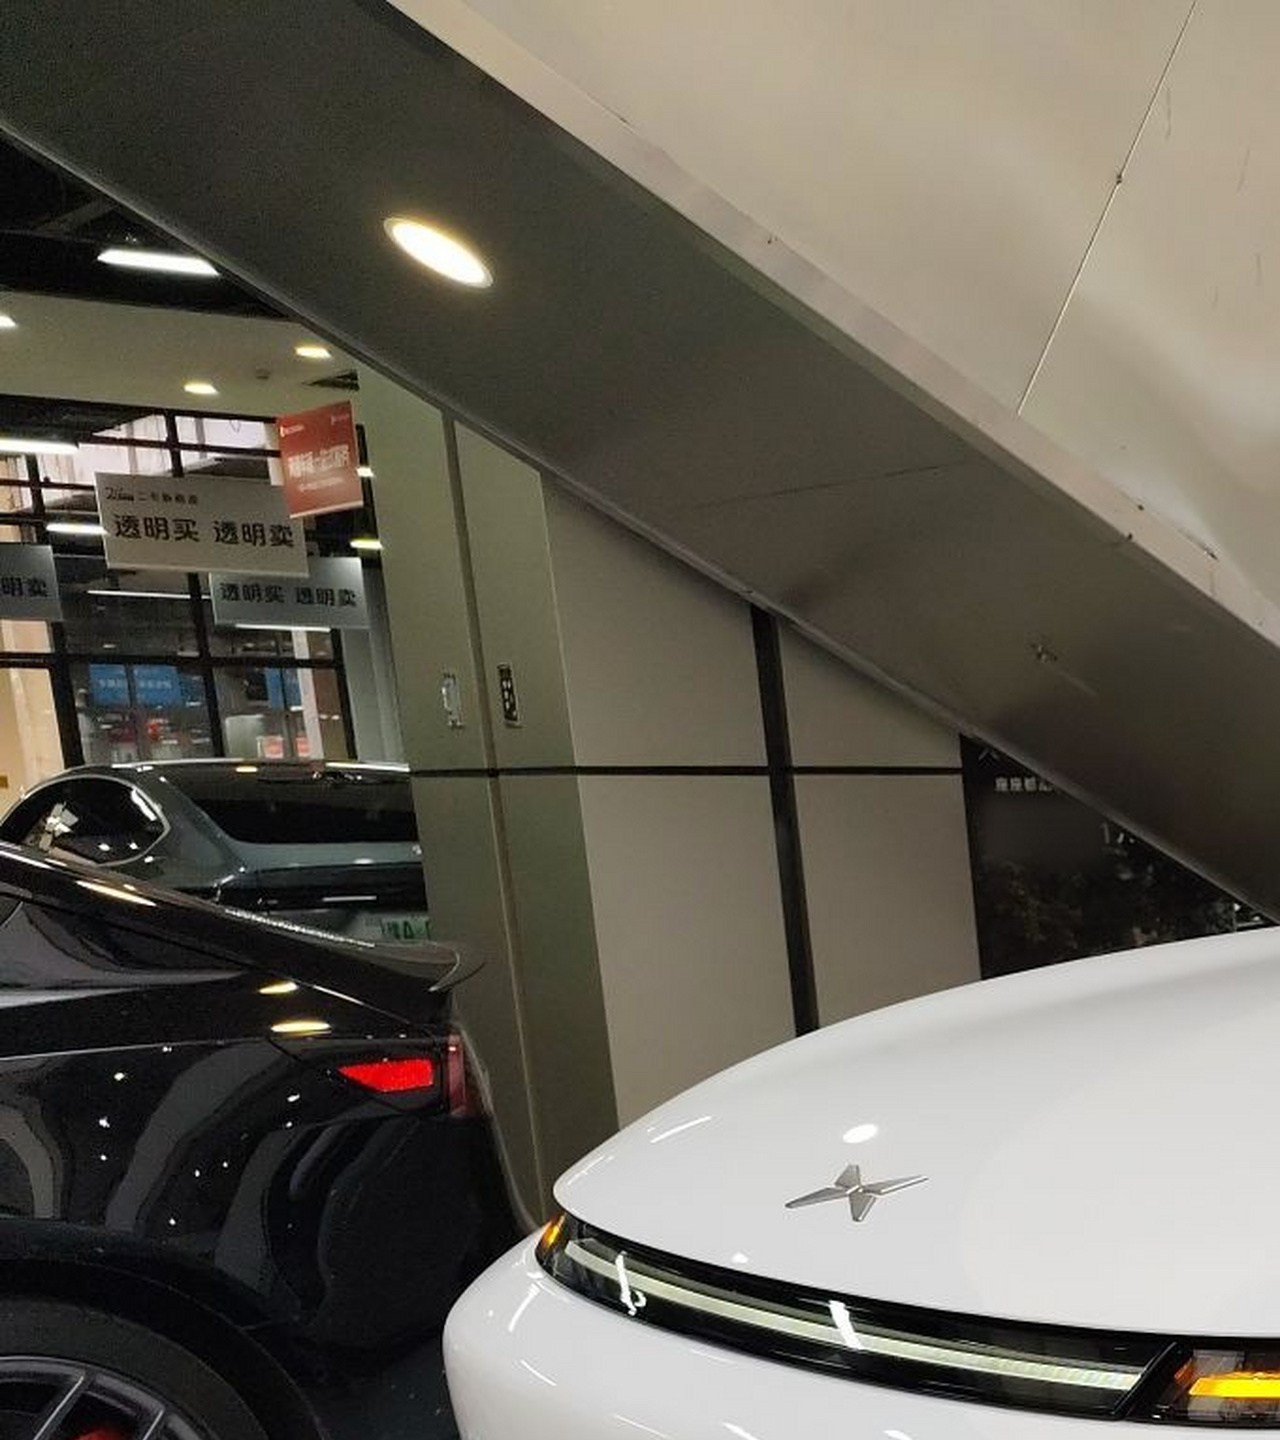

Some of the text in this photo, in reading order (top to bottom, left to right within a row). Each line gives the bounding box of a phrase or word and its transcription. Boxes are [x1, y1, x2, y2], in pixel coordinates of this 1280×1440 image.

[114, 514, 295, 548] 透明买 透明卖
[219, 582, 358, 609] 透明买 透明卖
